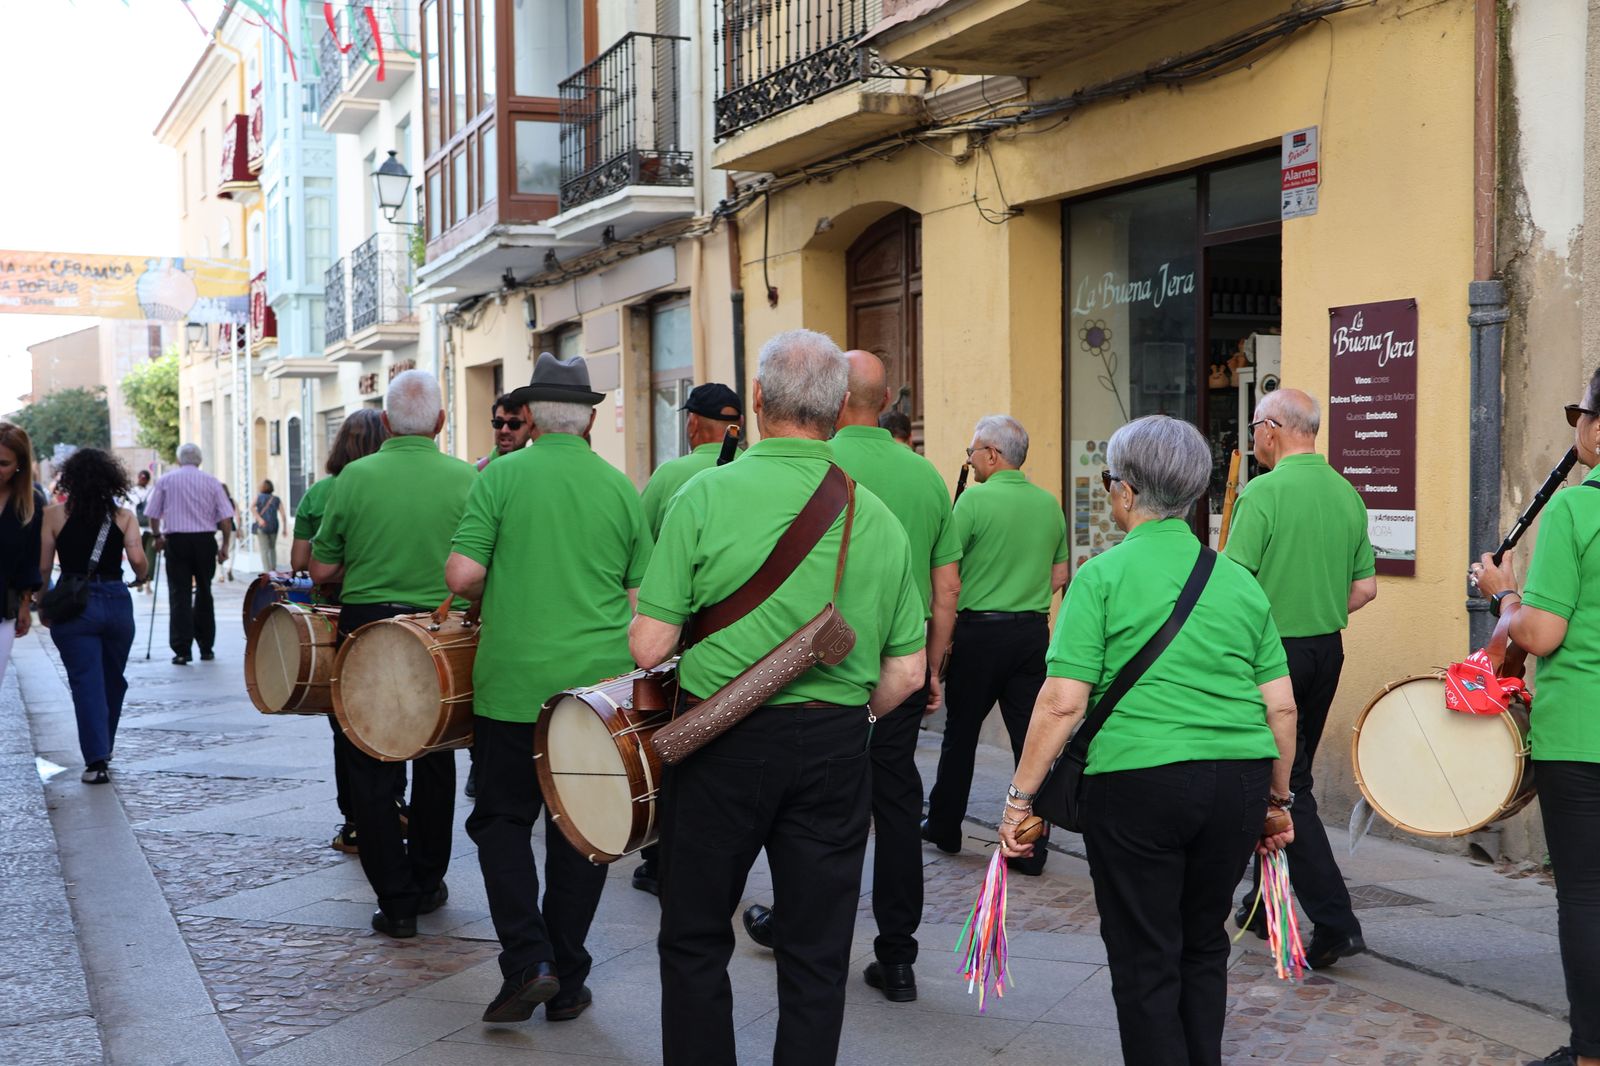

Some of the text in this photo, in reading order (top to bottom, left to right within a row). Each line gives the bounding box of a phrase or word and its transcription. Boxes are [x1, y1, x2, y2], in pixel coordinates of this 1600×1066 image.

[1284, 168, 1316, 182] Alarma
[1072, 262, 1195, 315] La Buena Jera
[1350, 311, 1364, 332] La
[1333, 327, 1415, 367] Buena Jera
[1355, 376, 1371, 385] Vinos
[1366, 411, 1398, 420] Embutidos
[1355, 430, 1388, 440] Legumbres
[1365, 484, 1398, 493] Recuerdos
